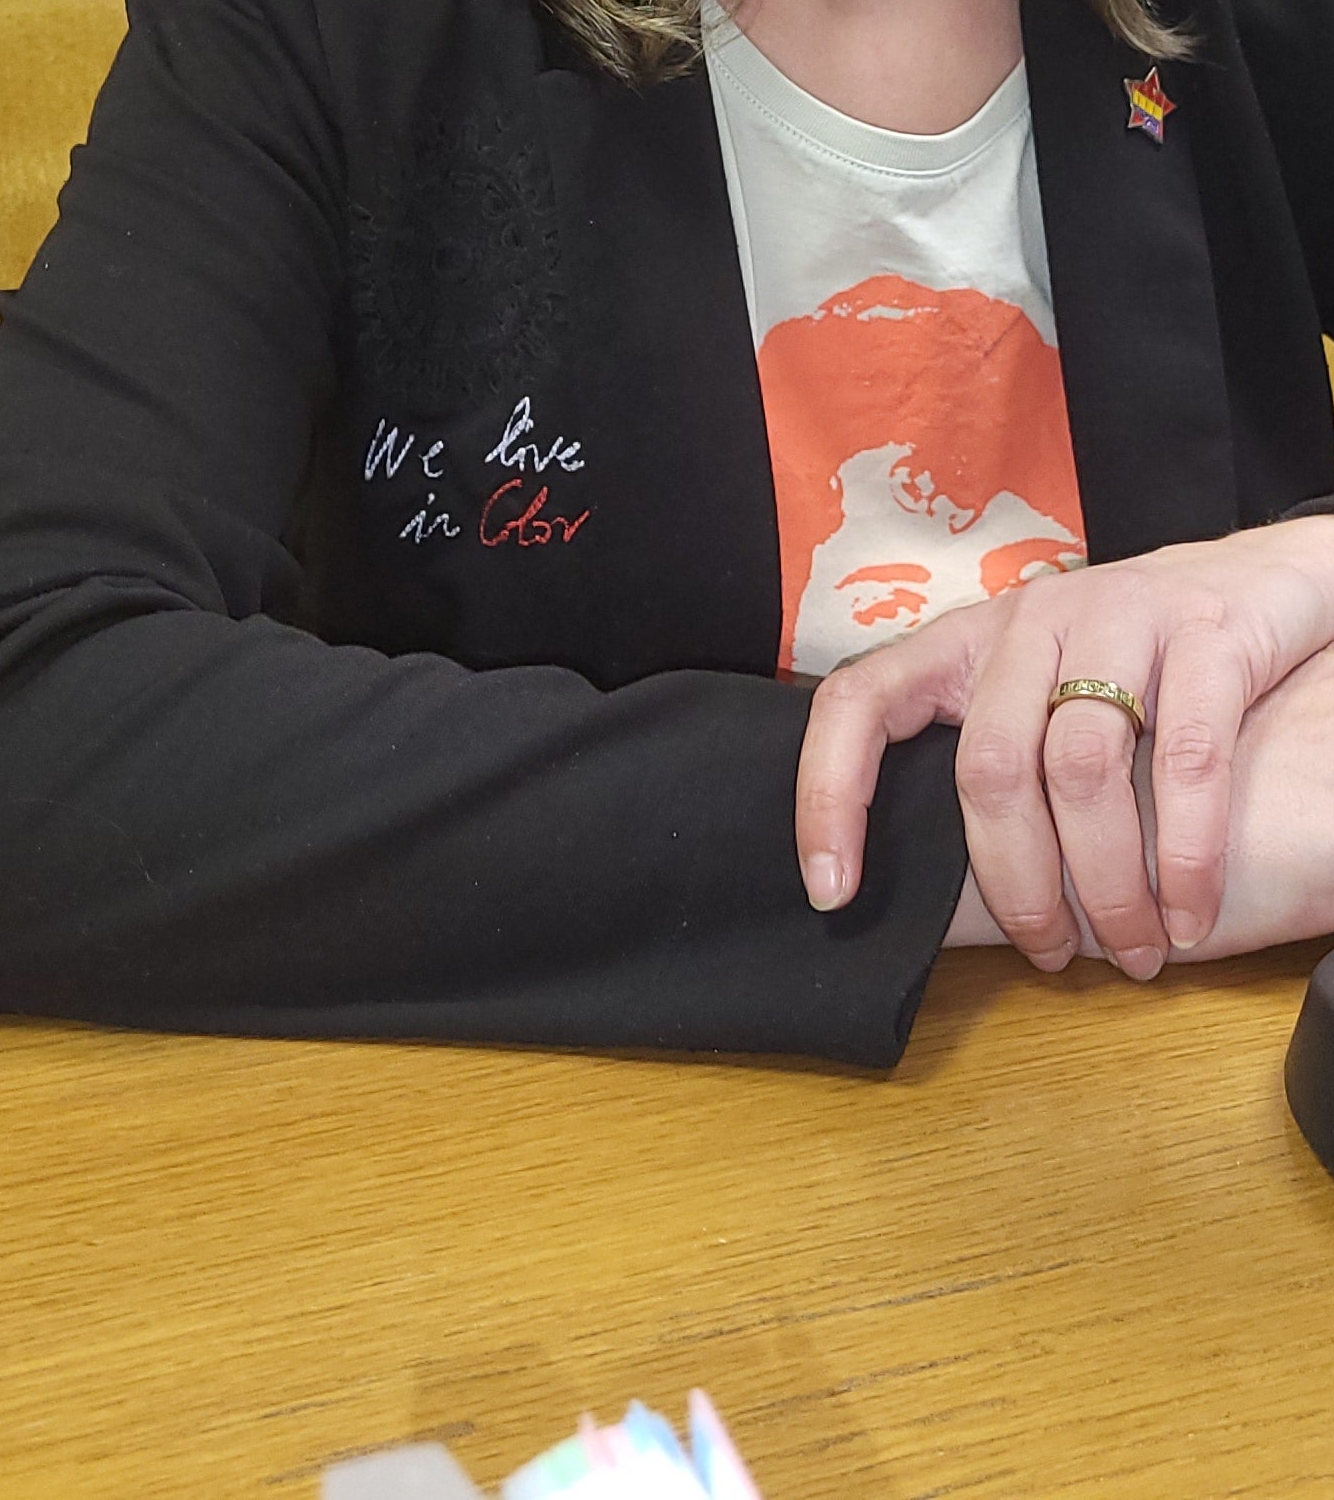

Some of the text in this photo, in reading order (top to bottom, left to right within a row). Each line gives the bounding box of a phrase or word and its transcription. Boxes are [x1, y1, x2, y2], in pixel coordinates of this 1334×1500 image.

[364, 395, 586, 481] We love
[398, 492, 461, 544] in
